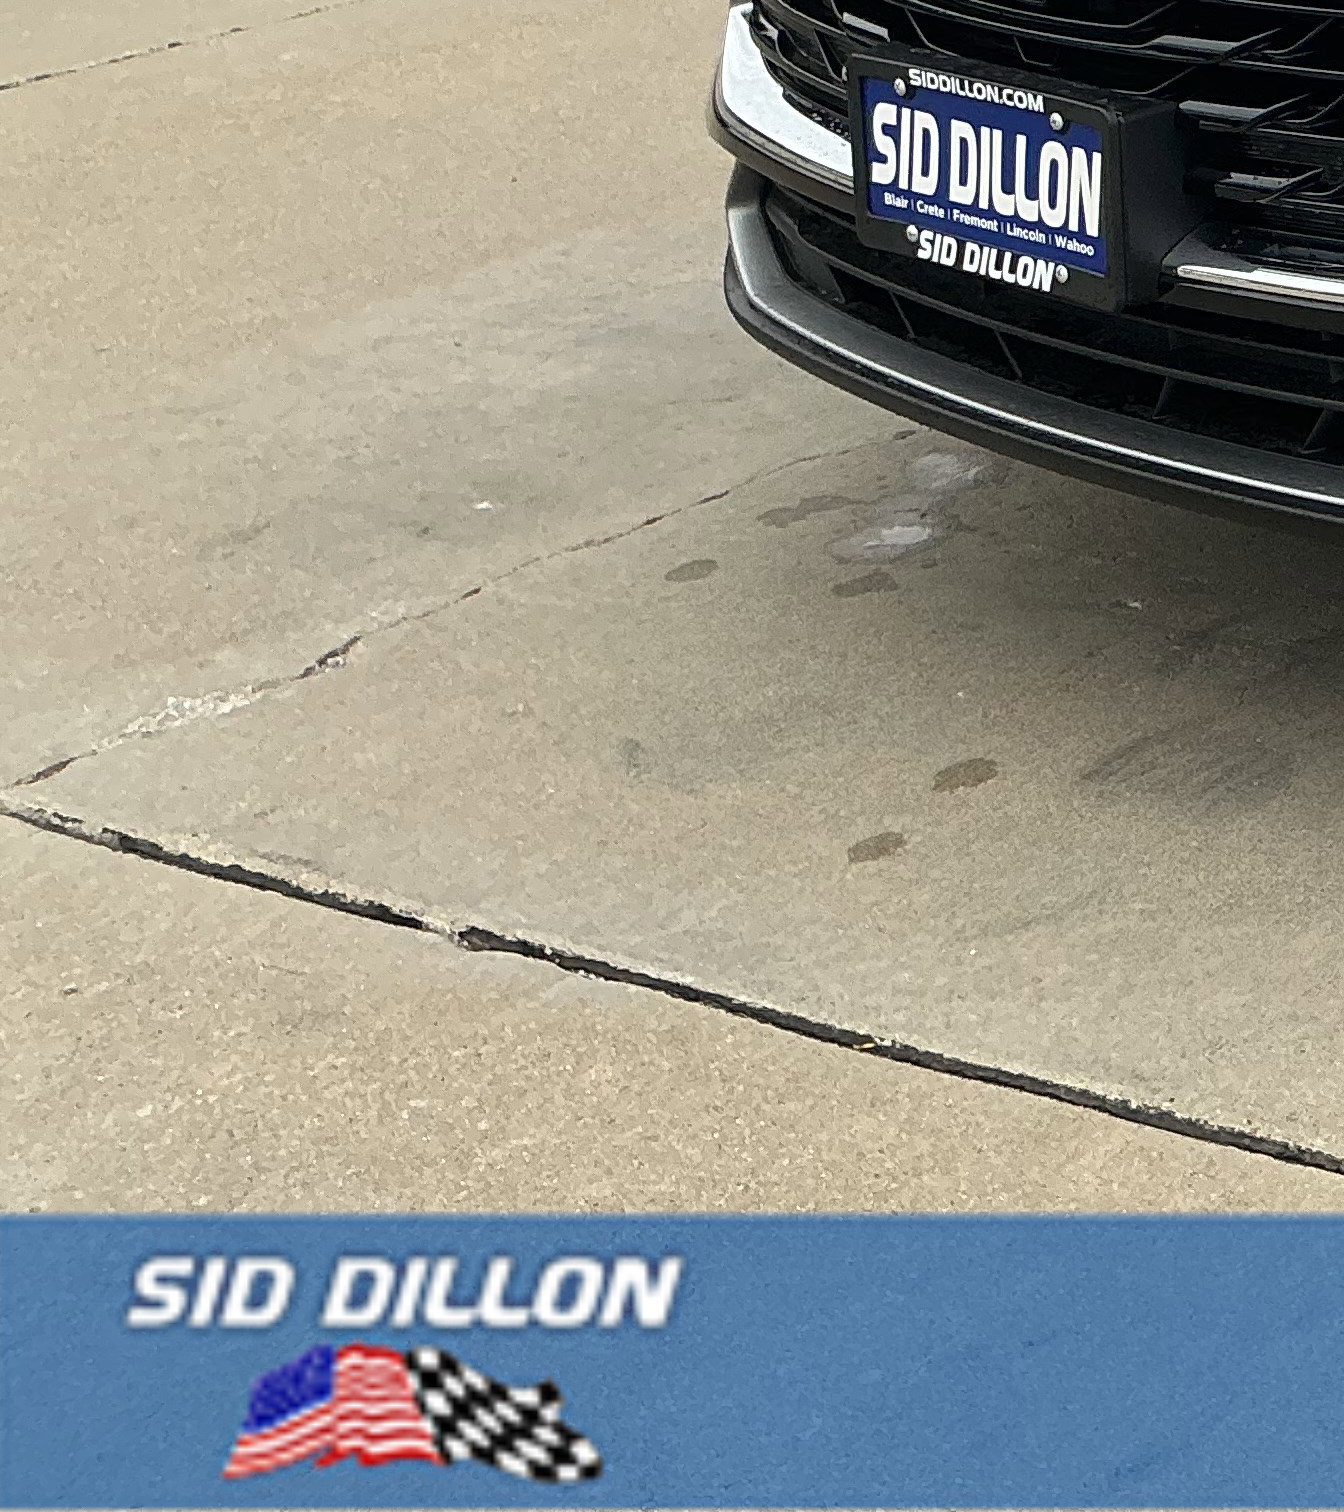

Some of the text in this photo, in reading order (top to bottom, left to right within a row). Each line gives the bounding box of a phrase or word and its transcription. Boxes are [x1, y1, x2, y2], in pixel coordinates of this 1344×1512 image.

[908, 68, 1044, 113] SIDDILLON.COM
[870, 102, 1102, 238] SID DILLON
[884, 192, 1095, 257] Blair Crete Fremont Lincoln Wahoo
[917, 229, 1056, 293] SID DILLON
